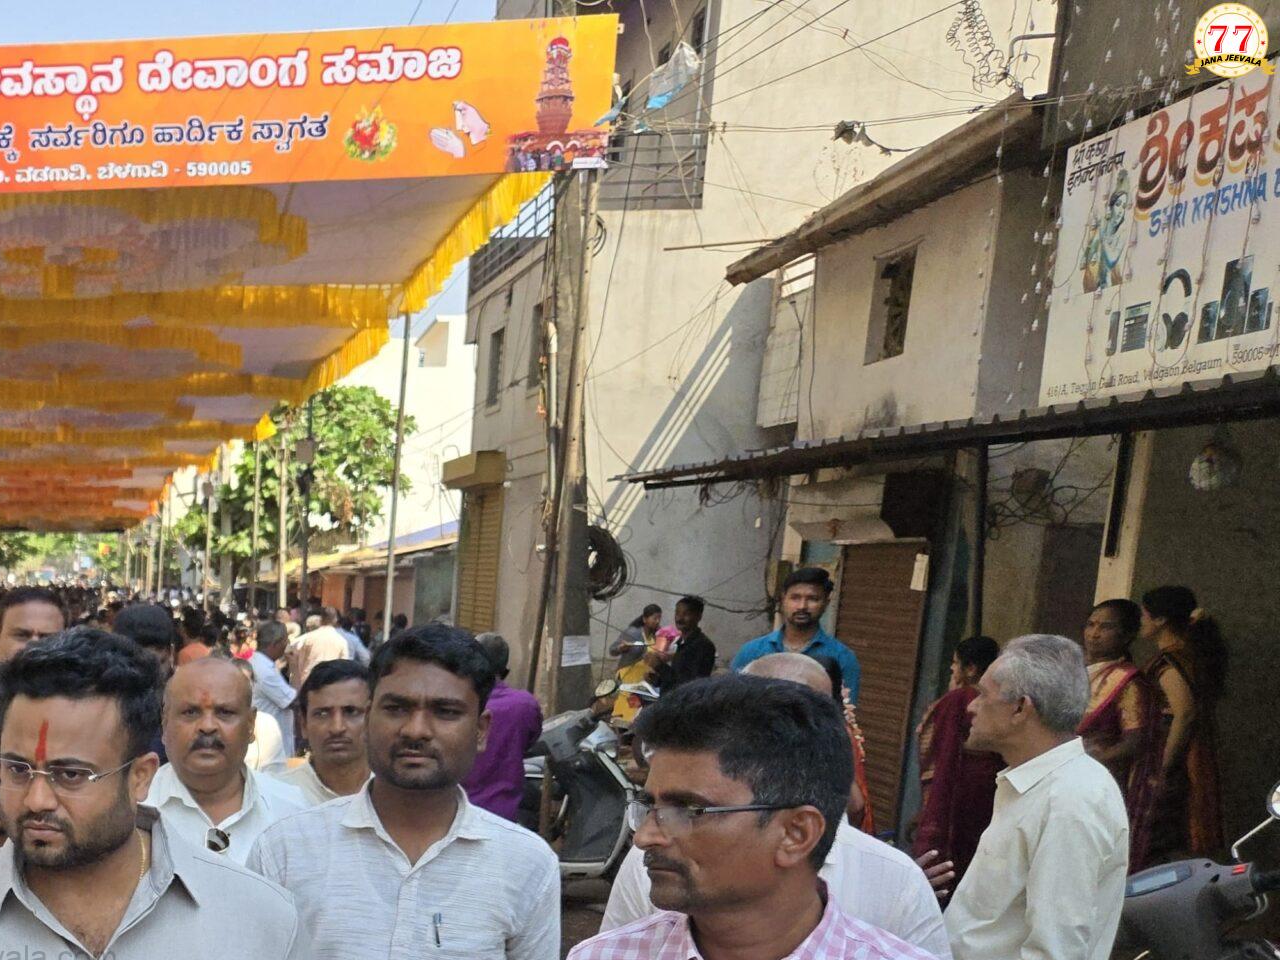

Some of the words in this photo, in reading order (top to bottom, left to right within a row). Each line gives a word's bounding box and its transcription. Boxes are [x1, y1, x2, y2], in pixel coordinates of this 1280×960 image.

[138, 50, 308, 91] ದೇವಾಂಗ
[322, 44, 462, 84] ಸಮಾಜ
[30, 121, 145, 149] ಸರ್ವರಿಗೂ
[153, 116, 244, 144] ಹಾರ್ದಿಕ
[252, 114, 329, 151] ಸ್ವಾಗತ
[186, 160, 252, 177] 590005
[1191, 172, 1268, 225] KRISHNA
